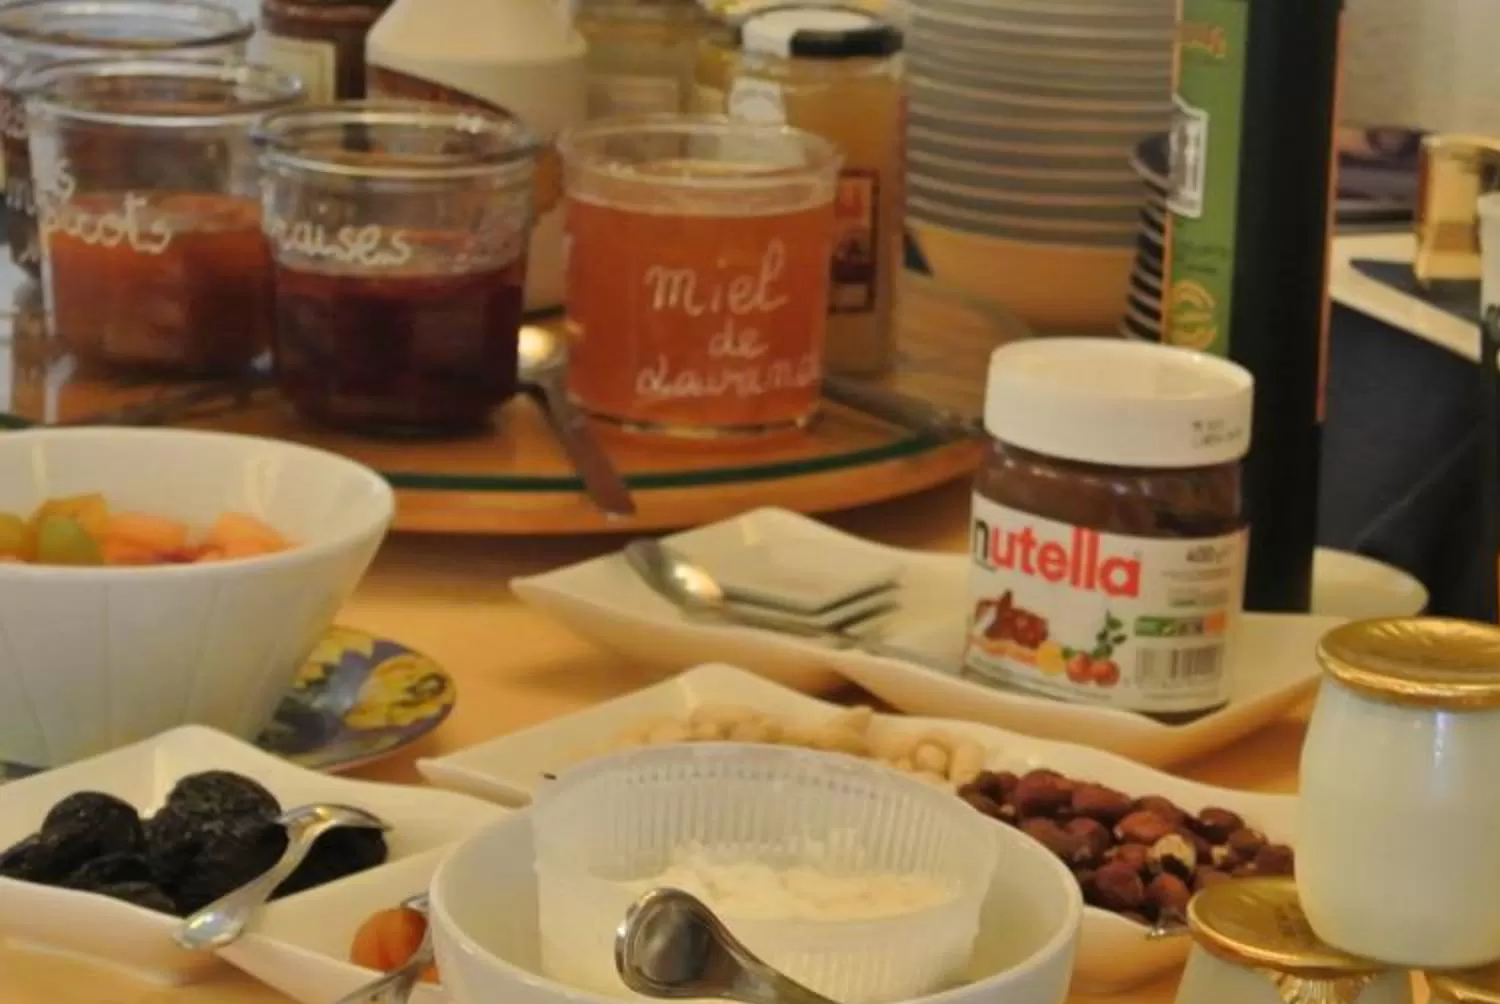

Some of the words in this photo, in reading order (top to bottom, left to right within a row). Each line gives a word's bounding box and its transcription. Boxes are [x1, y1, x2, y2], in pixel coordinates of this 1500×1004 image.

[645, 236, 791, 317] Miel
[706, 317, 770, 359] de
[974, 517, 1142, 599] nutella
